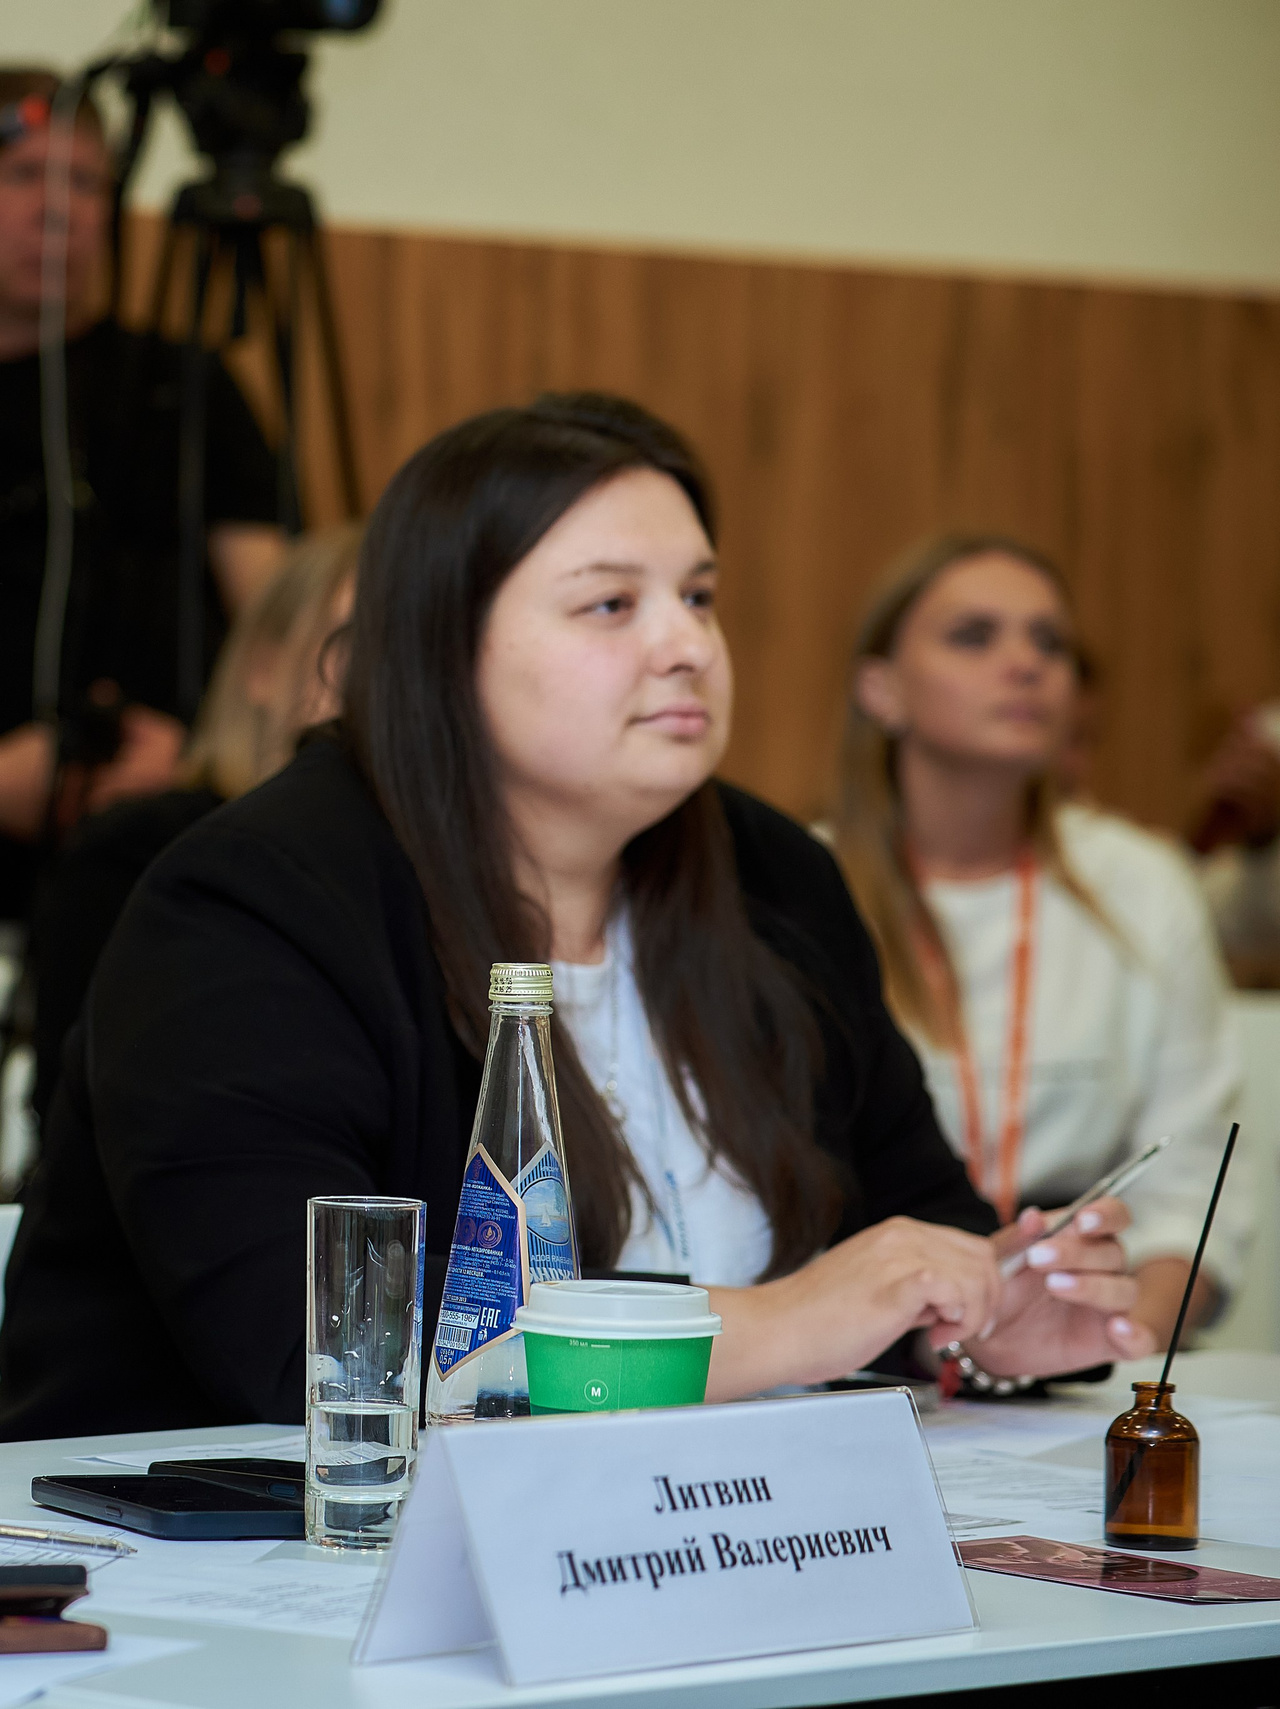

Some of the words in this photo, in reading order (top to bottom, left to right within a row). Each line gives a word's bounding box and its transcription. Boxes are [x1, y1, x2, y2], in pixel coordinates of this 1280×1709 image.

[653, 1474, 774, 1514] Литвин
[556, 1536, 707, 1596] Дмитрий
[709, 1524, 894, 1573] Валериевич
